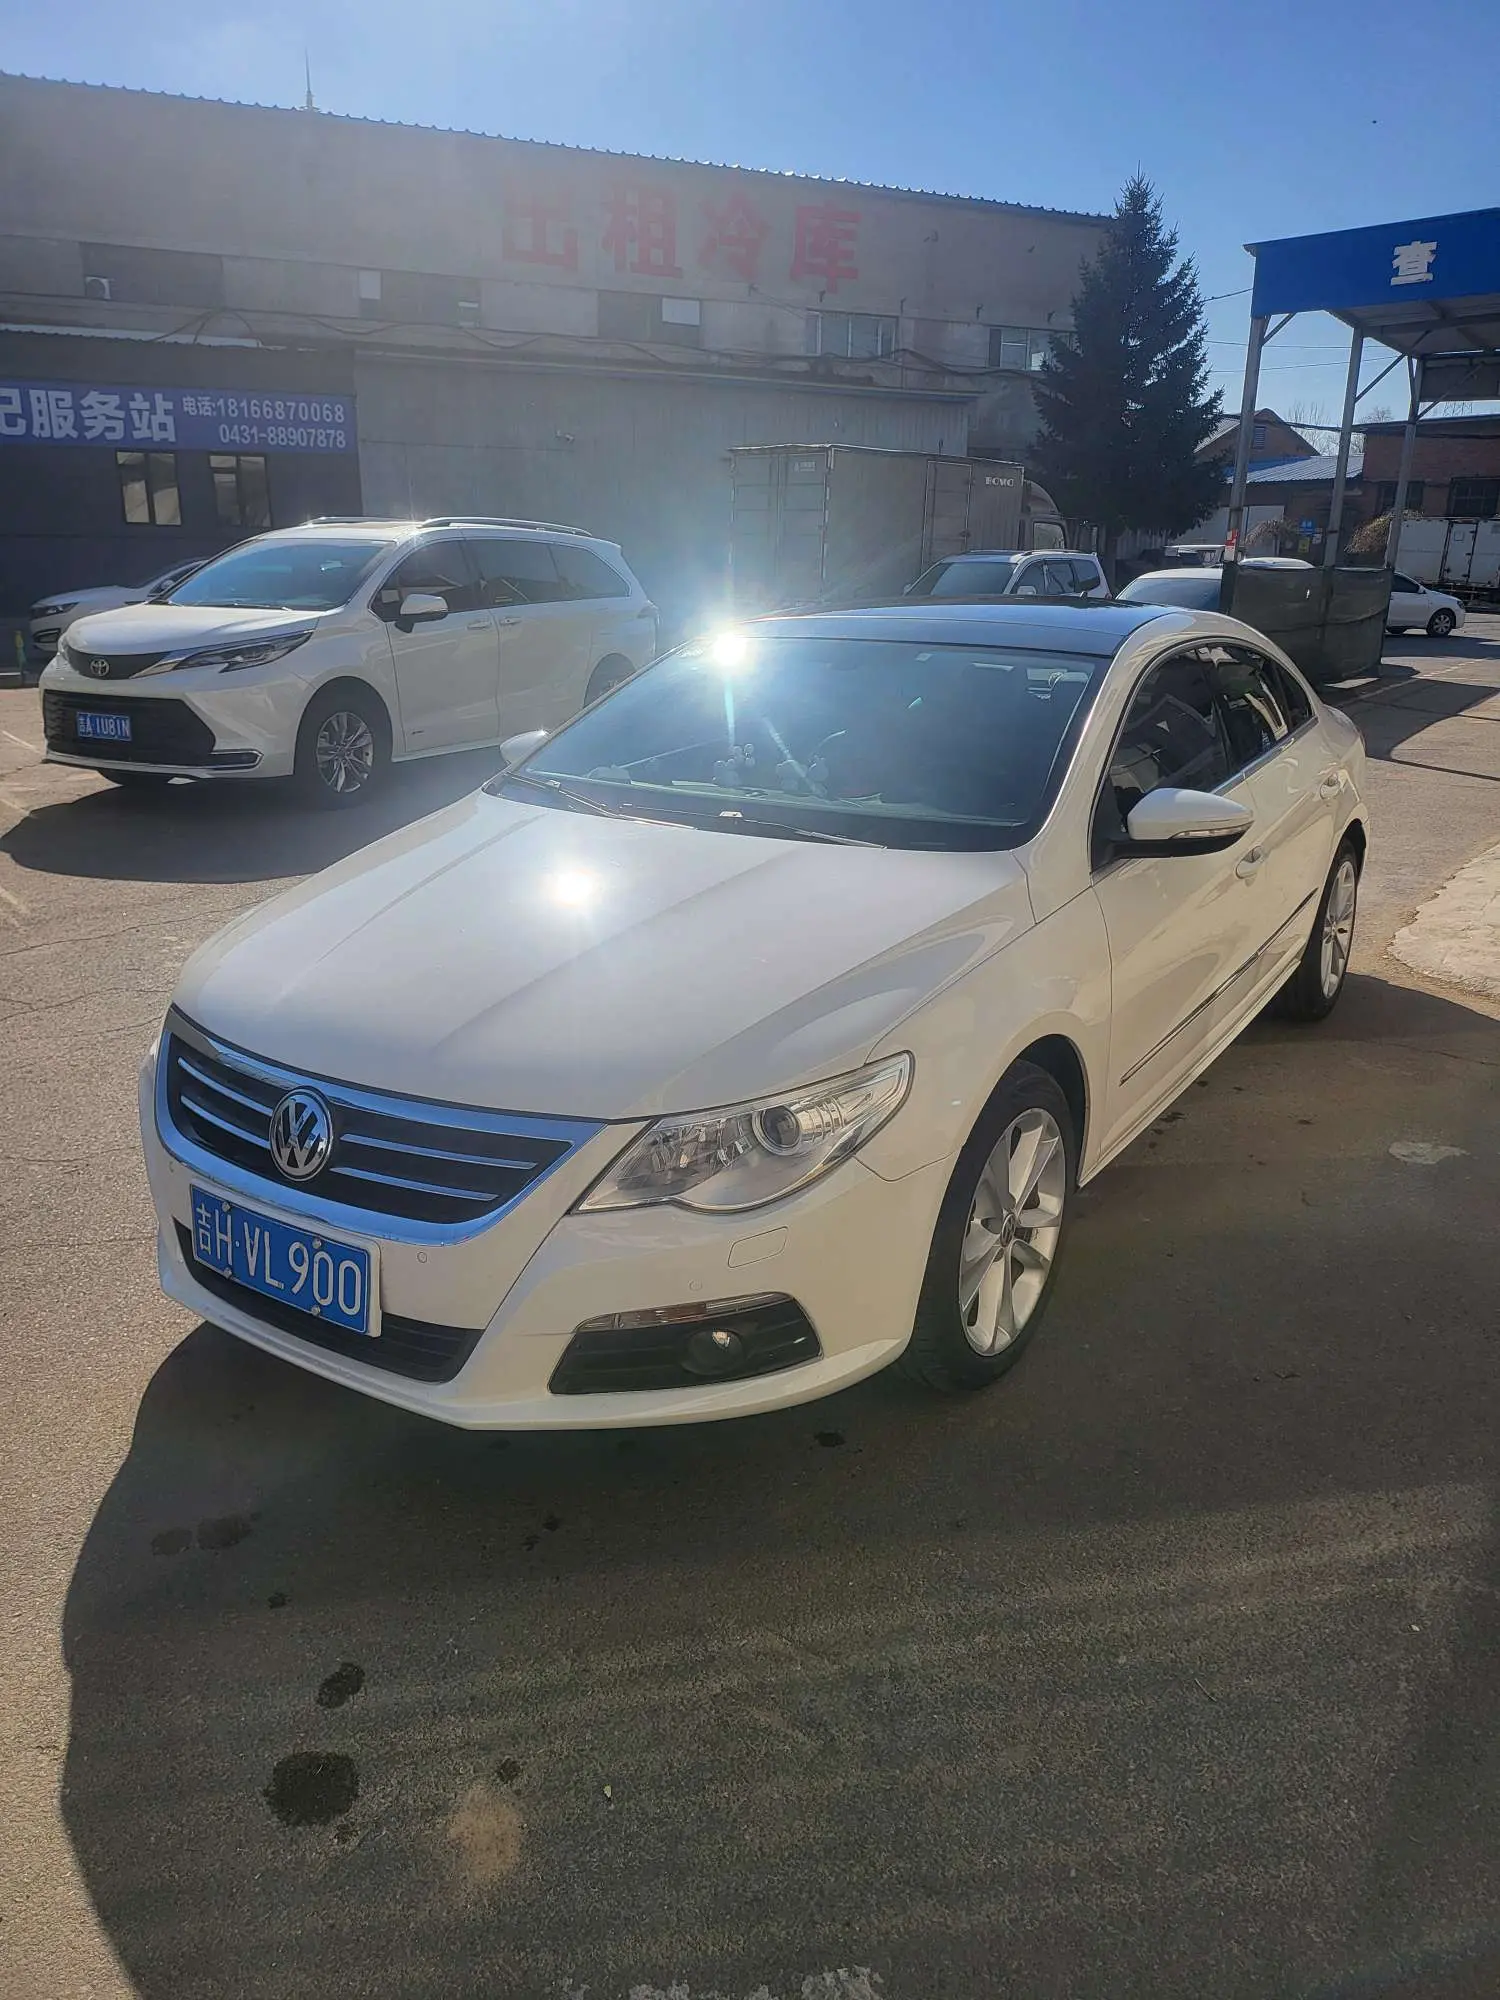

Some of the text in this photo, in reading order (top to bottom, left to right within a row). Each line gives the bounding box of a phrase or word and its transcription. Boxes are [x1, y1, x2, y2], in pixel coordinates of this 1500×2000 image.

[502, 184, 862, 295] 出租冷库
[219, 424, 347, 449] 0431-88907878
